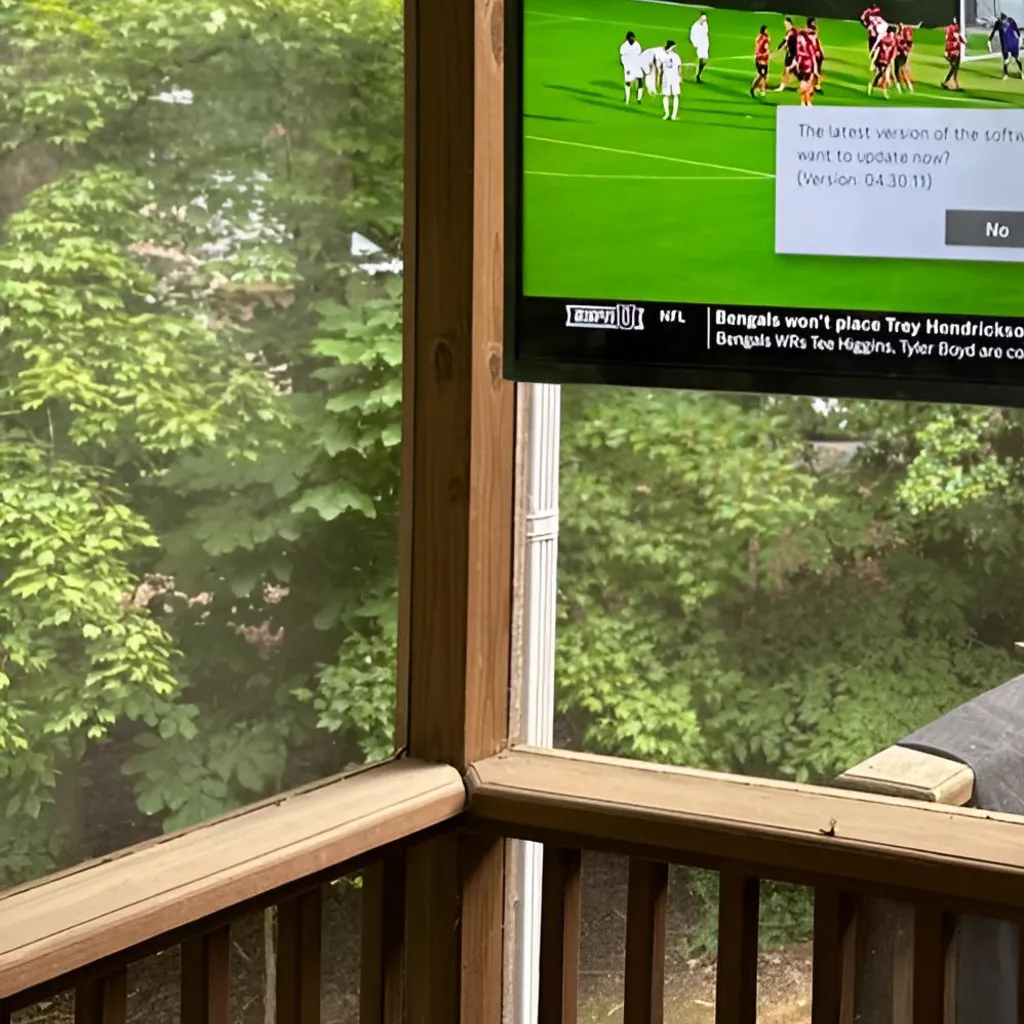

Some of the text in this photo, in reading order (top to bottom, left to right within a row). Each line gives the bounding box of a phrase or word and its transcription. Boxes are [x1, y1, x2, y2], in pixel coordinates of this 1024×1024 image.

[799, 124, 824, 139] The
[828, 124, 871, 140] latest
[877, 128, 930, 141] version
[934, 127, 949, 141] of
[955, 127, 979, 142] the
[797, 150, 950, 166] want to update now?
[985, 222, 1009, 238] No
[716, 309, 780, 329] Bengals
[785, 314, 830, 330] won't
[836, 315, 881, 333] place
[885, 317, 921, 336] Trey
[716, 331, 772, 349] Bengals
[775, 333, 807, 350] WRs
[810, 335, 834, 351] Tee
[899, 339, 935, 358] Tyler
[938, 341, 976, 360] Boyd
[978, 344, 1003, 360] are
